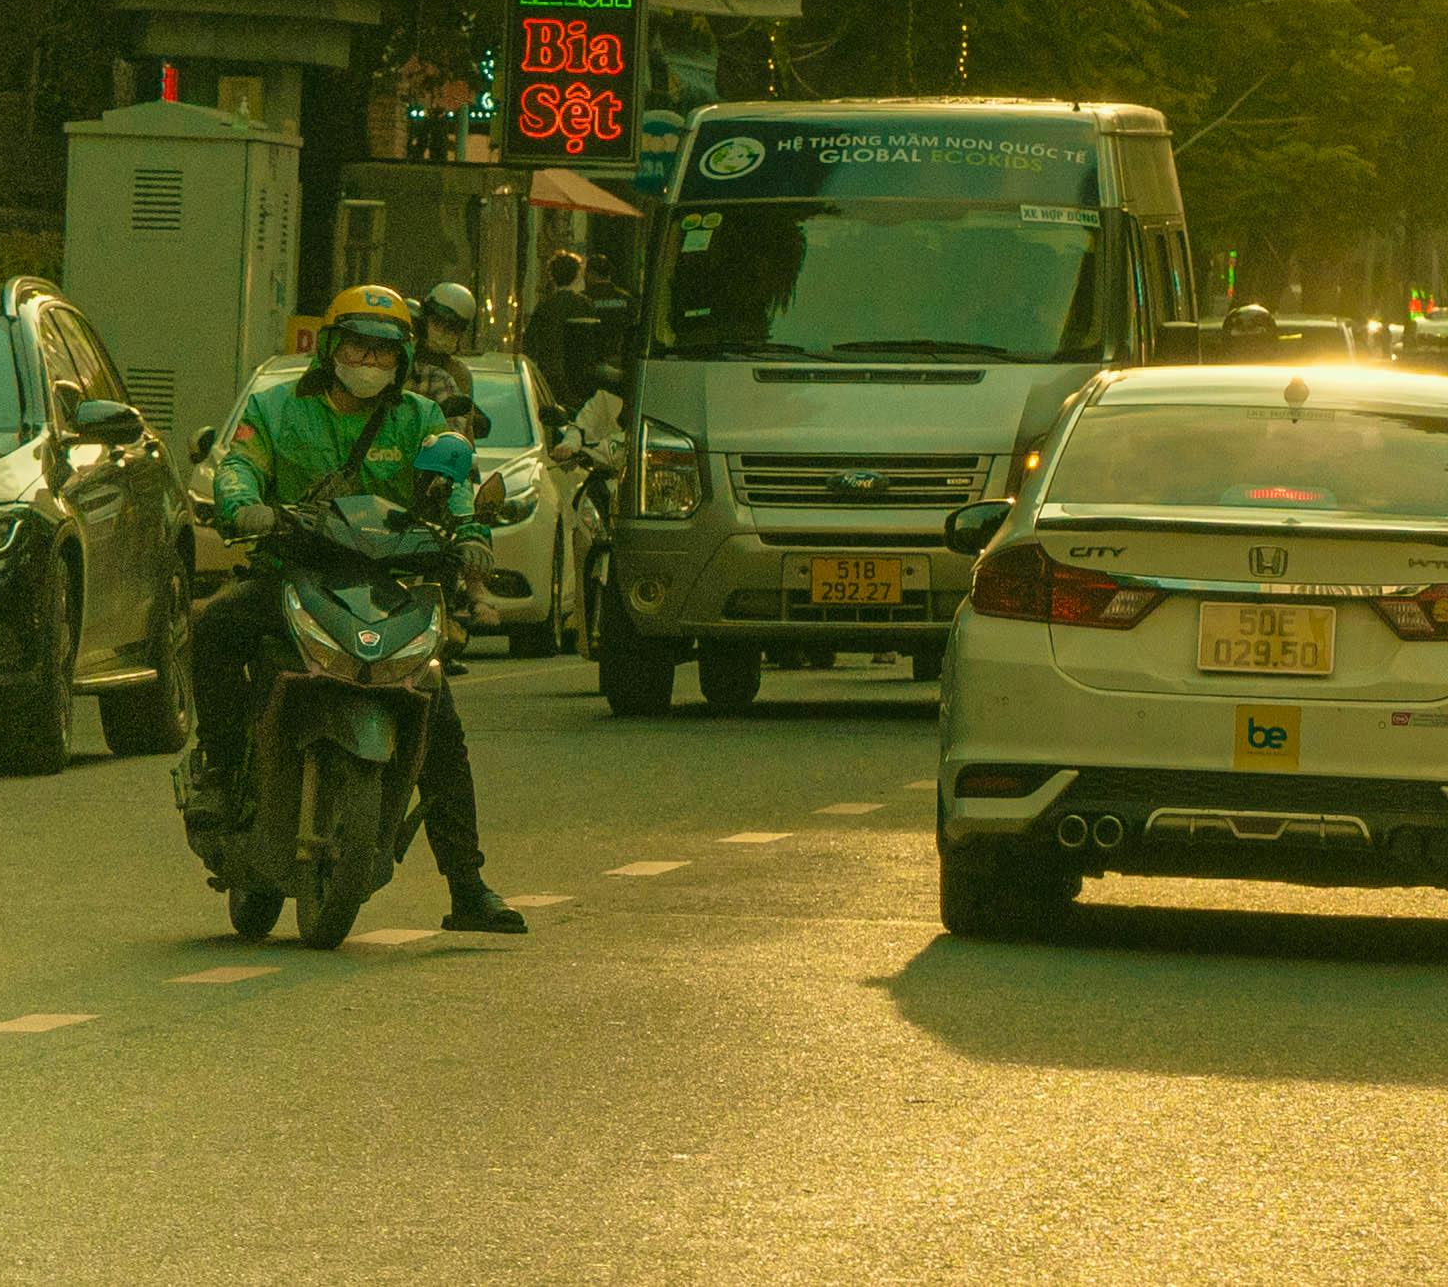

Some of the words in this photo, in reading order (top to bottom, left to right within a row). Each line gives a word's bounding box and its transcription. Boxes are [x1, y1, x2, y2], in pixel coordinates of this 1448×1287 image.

[521, 18, 624, 75] Bia
[519, 81, 622, 154] Sệt
[777, 135, 803, 152] HỆ
[946, 137, 993, 150] NON
[819, 148, 922, 164] GLOBAL
[931, 150, 1042, 172] ECOKIDS
[366, 446, 402, 461] Grab
[1069, 545, 1128, 558] CITY
[837, 560, 876, 579] 51B
[821, 581, 891, 601] 292.27
[1239, 608, 1297, 637] 50E
[1214, 638, 1319, 669] 029.50
[1248, 716, 1287, 749] be
